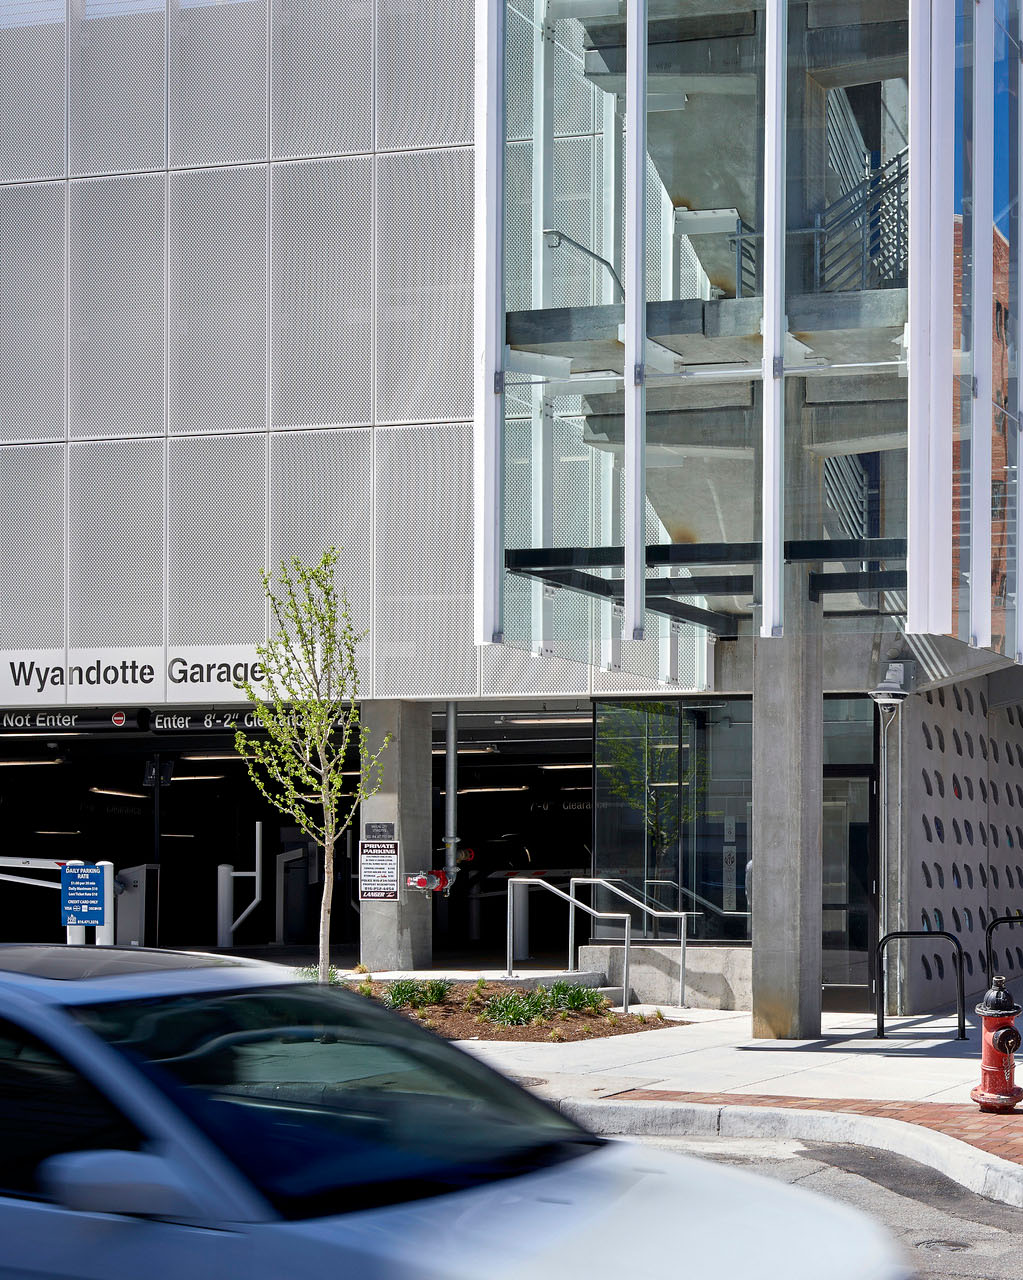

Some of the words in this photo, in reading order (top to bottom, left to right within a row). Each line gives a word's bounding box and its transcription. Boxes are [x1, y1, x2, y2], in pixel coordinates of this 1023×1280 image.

[9, 659, 155, 693] Wyandotte
[168, 657, 266, 689] Garage
[3, 712, 31, 727] Not
[36, 712, 78, 727] Enter
[155, 713, 191, 729] Enter
